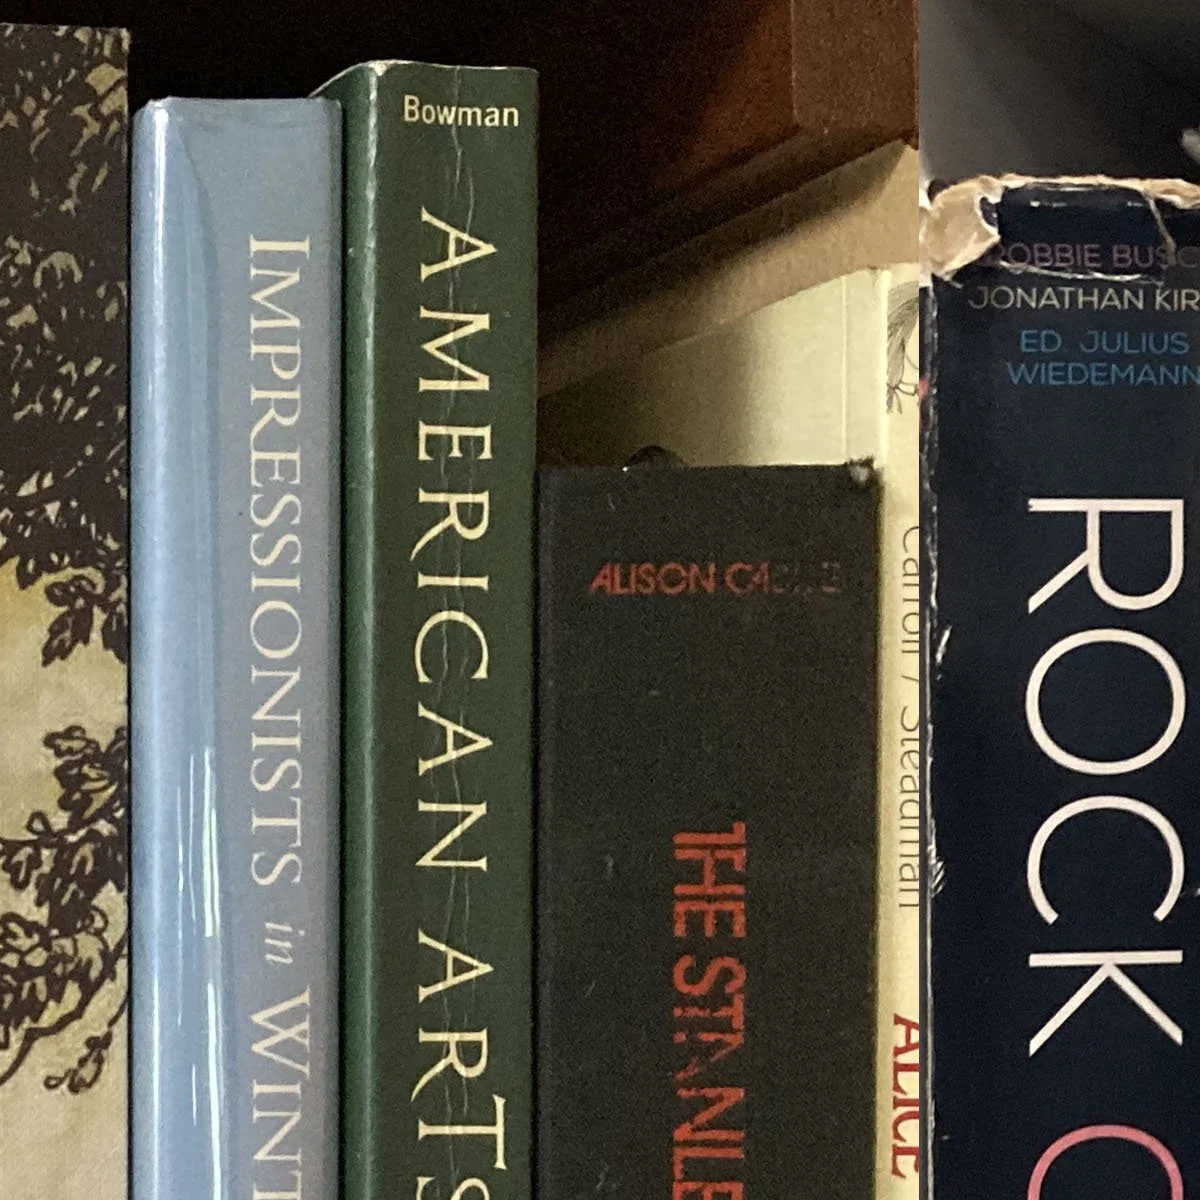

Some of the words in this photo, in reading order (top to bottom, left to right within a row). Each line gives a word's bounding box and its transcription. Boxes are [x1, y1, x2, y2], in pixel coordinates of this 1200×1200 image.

[402, 95, 520, 128] Bowman
[968, 286, 1144, 310] JONATHAN
[1079, 330, 1190, 355] JULIUS
[1007, 361, 1200, 386] WIEDEMANN
[248, 235, 310, 886] IMPRESSIONISTS
[409, 206, 498, 872] AMERICAN
[589, 562, 717, 595] ALISON
[1025, 499, 1186, 1056] ROCK
[672, 821, 747, 939] THE
[264, 921, 305, 966] in
[892, 1014, 919, 1180] ALICE
